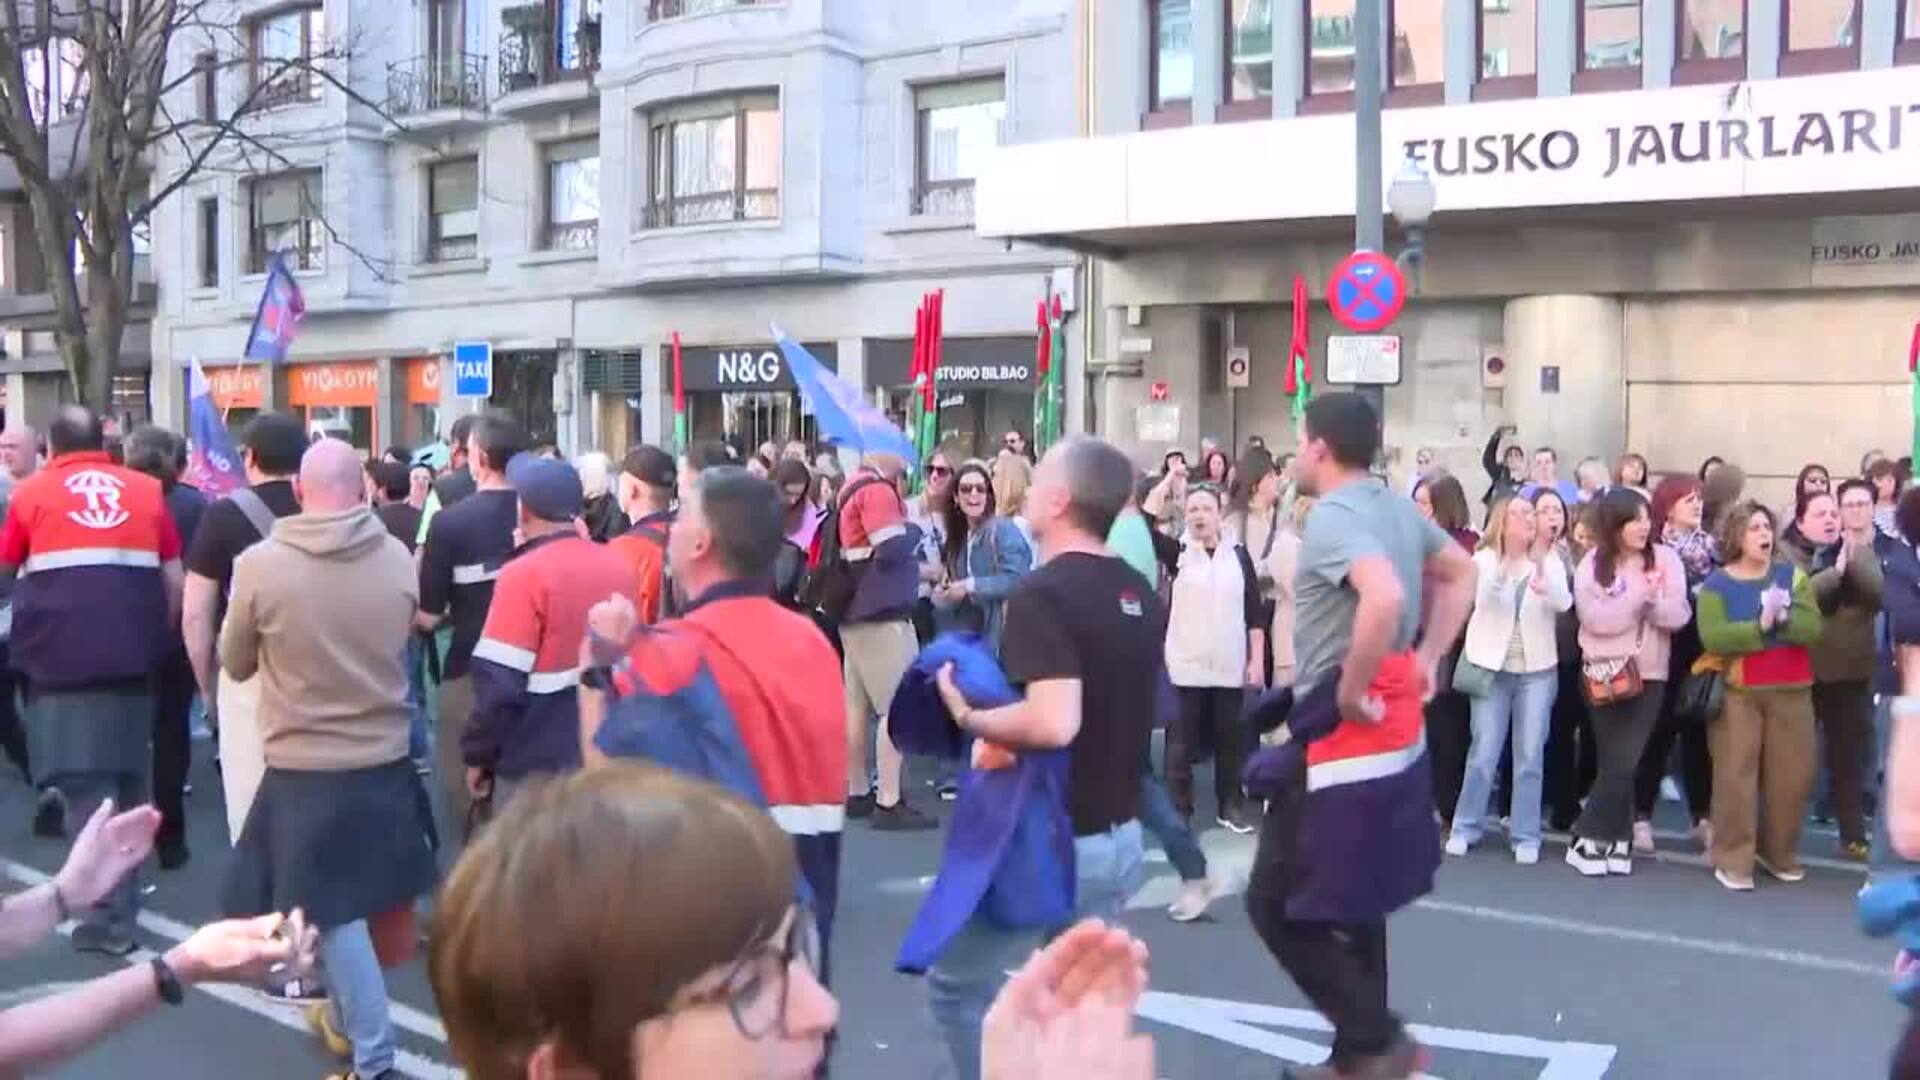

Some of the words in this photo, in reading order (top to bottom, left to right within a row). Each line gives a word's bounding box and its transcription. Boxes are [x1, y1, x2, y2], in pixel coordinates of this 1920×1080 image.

[1402, 129, 1580, 177] EUSKO
[1811, 243, 1881, 261] EUSKO
[456, 360, 489, 379] TAXI
[719, 352, 780, 383] N&G
[981, 365, 1029, 380] BILBAO
